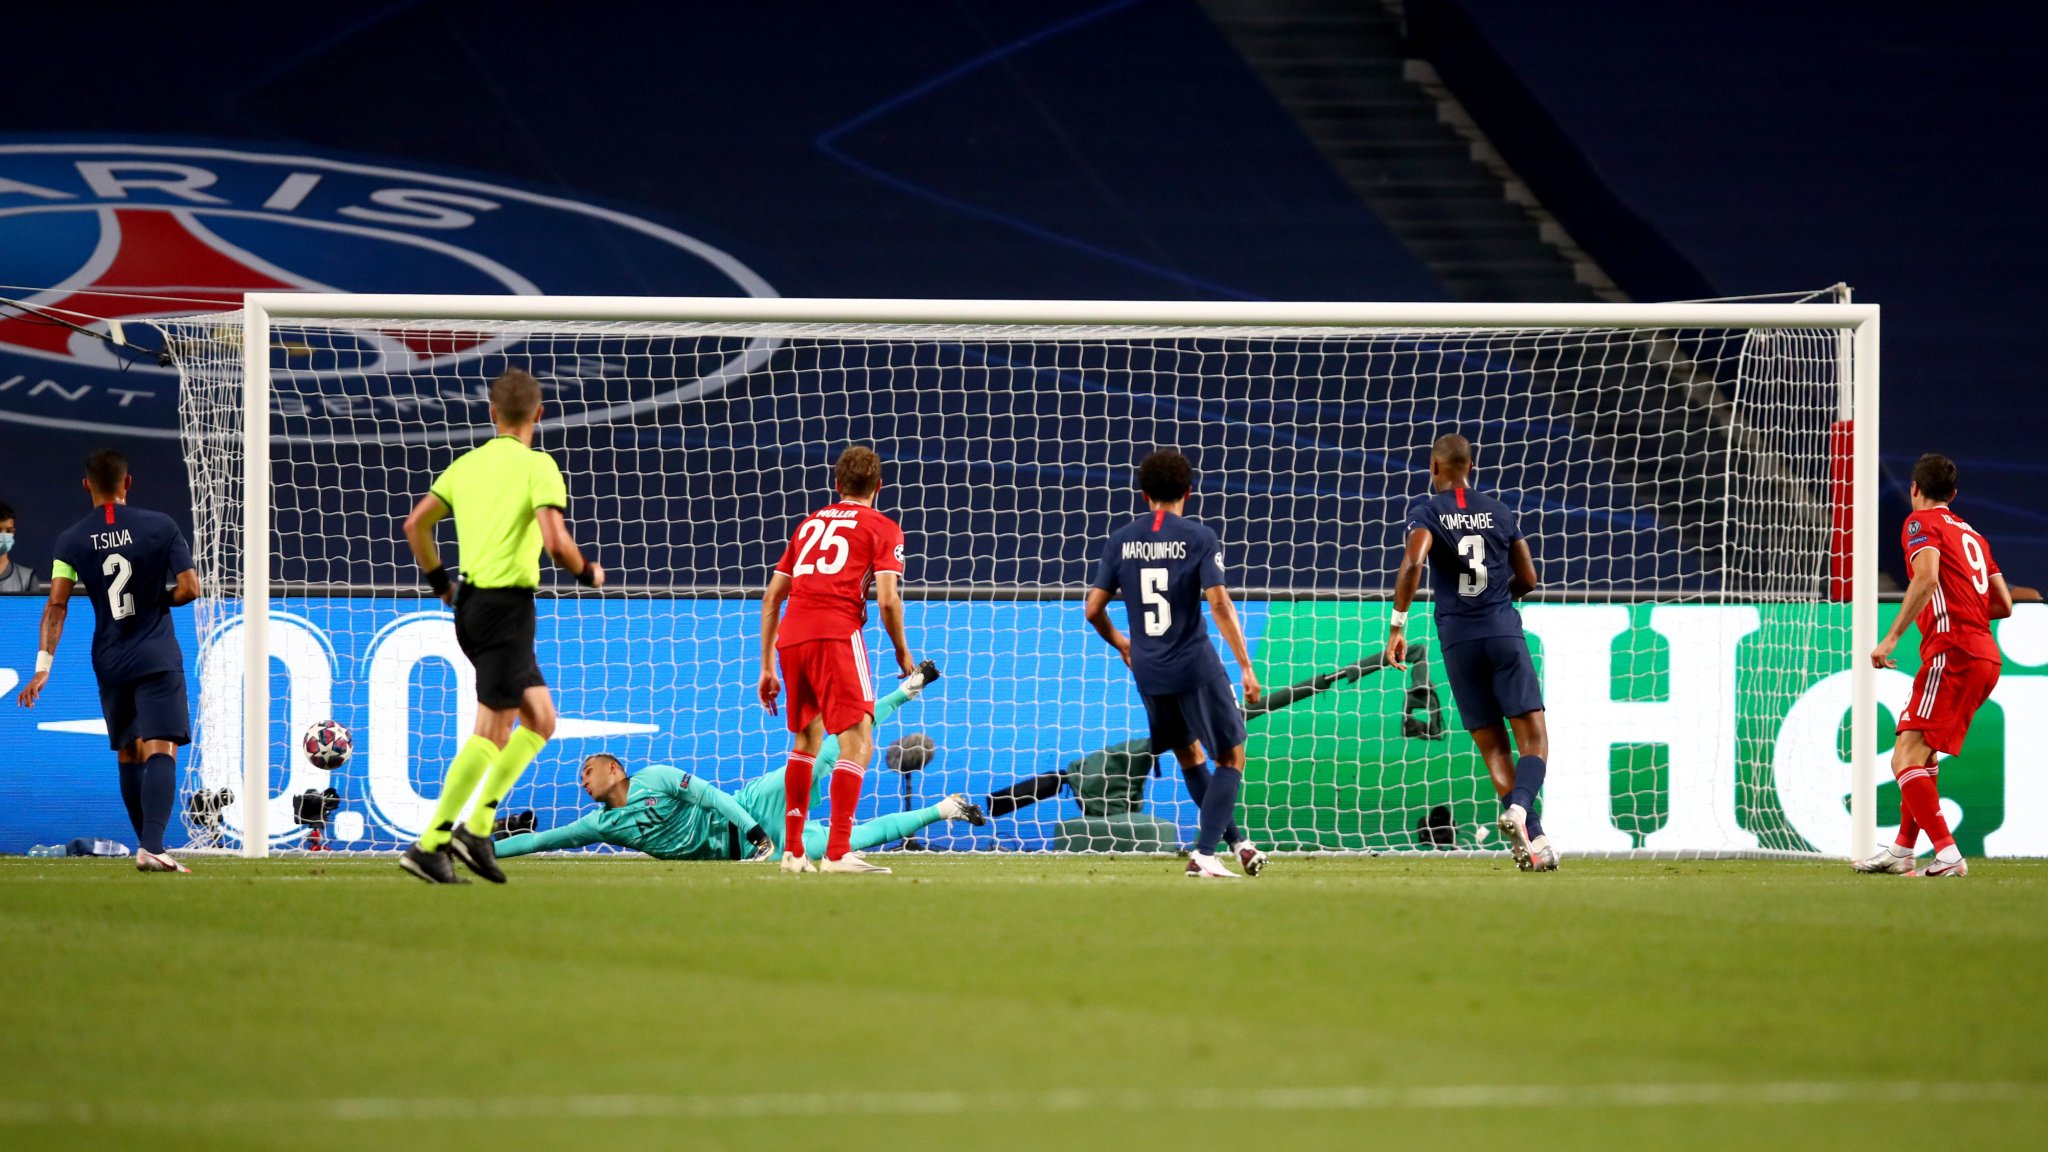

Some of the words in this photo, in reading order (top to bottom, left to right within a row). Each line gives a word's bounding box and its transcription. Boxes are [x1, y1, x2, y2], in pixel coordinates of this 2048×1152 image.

[90, 528, 133, 551] T.SILVA
[792, 518, 859, 579] 25
[1122, 541, 1187, 562] MARQUINHOS
[1439, 512, 1495, 531] KIMPEMBE
[102, 553, 136, 620] 2
[1457, 534, 1488, 597] 3
[1961, 532, 1989, 595] 9
[1140, 567, 1172, 637] 5
